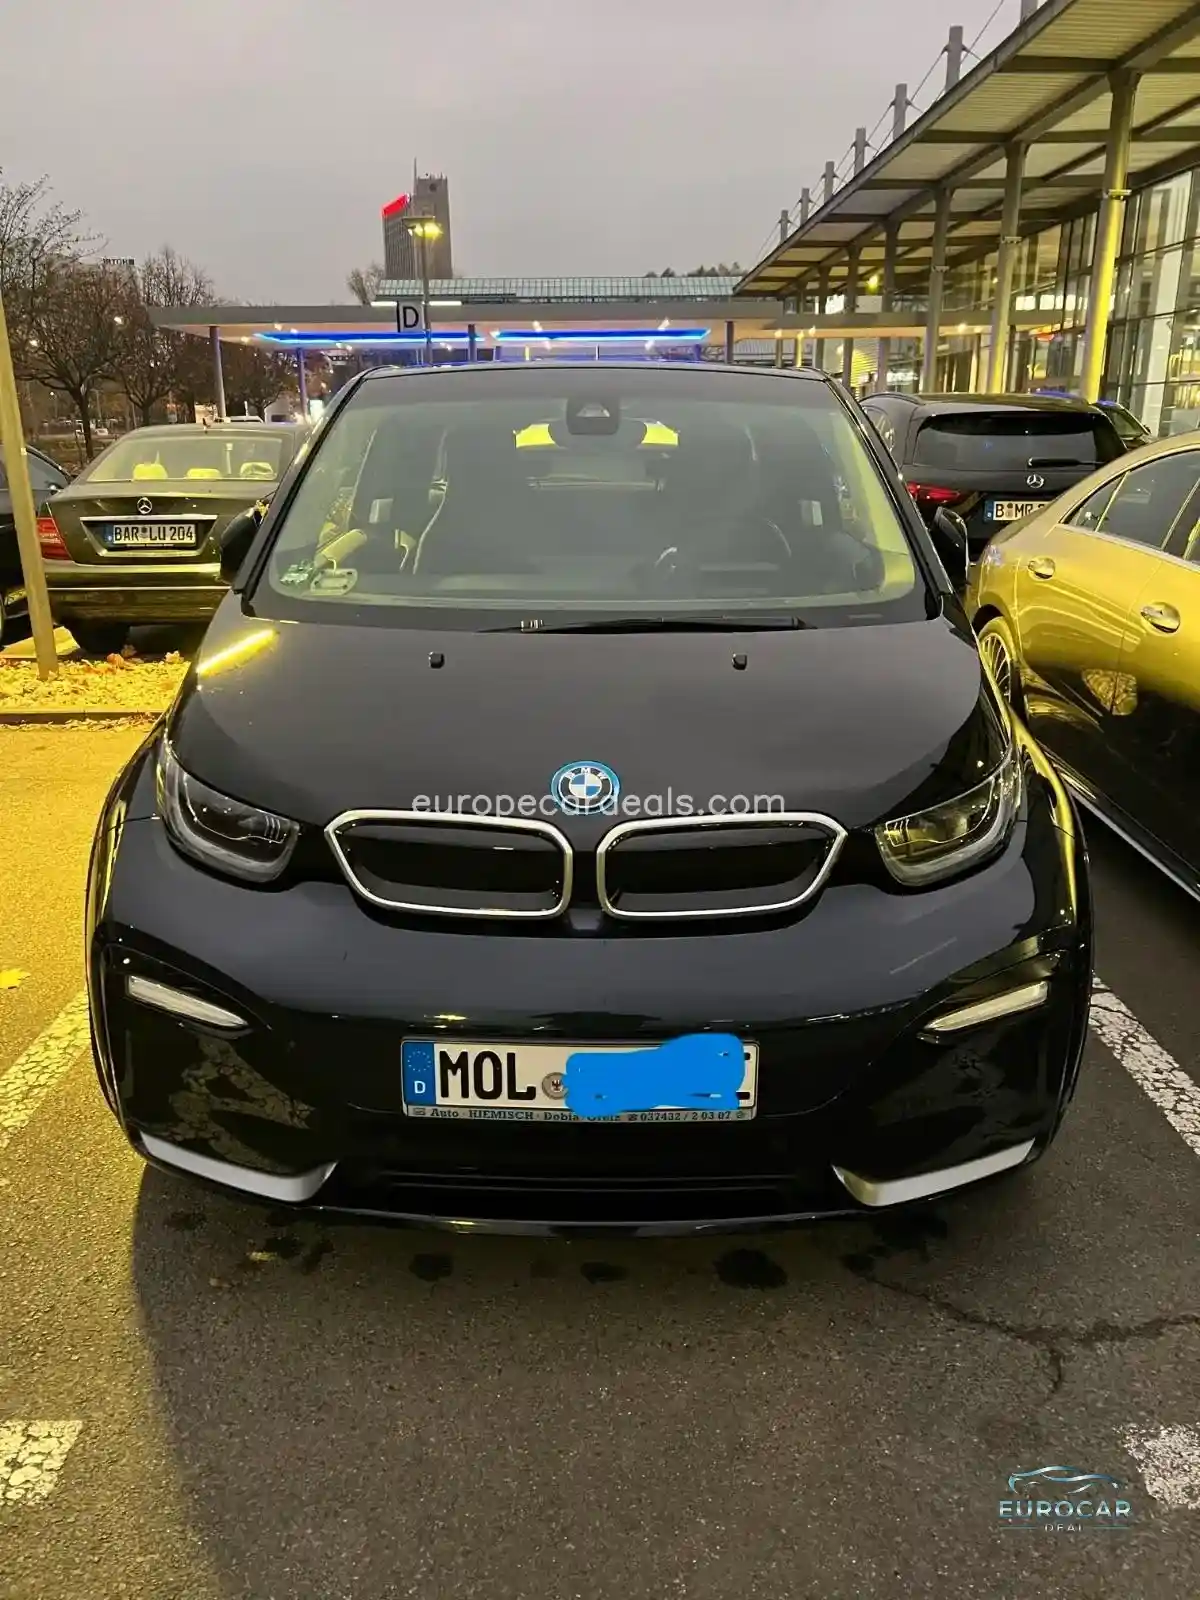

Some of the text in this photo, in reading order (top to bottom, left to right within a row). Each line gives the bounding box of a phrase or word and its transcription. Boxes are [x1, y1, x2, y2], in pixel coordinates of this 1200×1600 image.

[402, 306, 419, 328] D
[995, 503, 1004, 517] B
[114, 526, 193, 541] BAR LU 204
[439, 1050, 536, 1100] MOL
[414, 1080, 426, 1094] D
[430, 1108, 459, 1118] Auto
